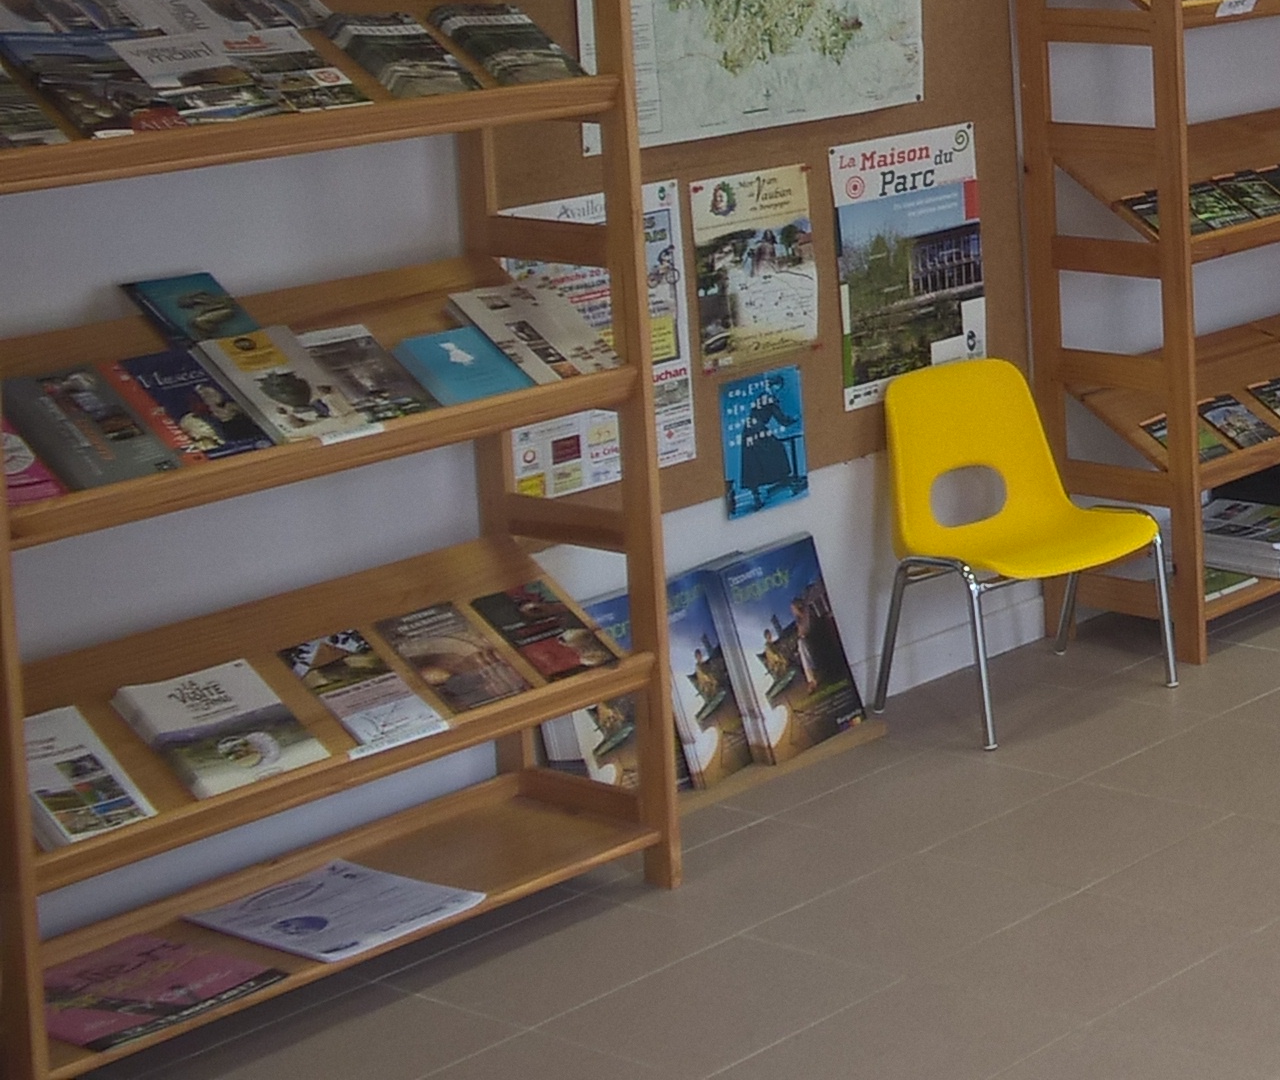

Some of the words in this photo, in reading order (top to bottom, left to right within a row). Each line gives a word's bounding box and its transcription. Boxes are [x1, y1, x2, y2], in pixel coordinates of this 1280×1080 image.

[859, 144, 930, 172] Maison
[934, 149, 953, 166] du
[879, 168, 935, 197] Parc
[652, 365, 688, 383] uchan
